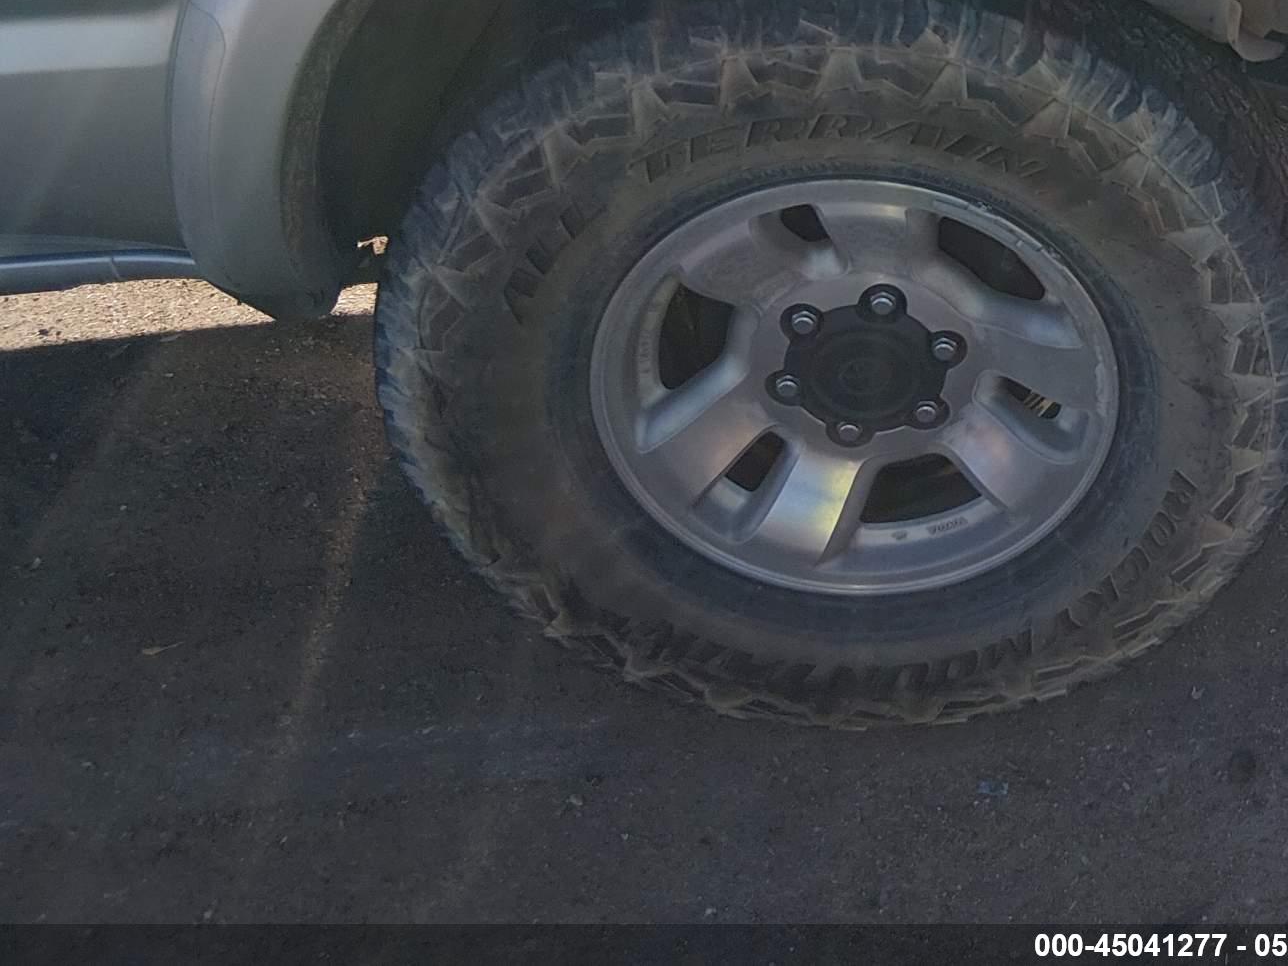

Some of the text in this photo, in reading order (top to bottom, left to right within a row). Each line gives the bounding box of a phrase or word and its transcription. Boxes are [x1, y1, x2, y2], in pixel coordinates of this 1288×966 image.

[503, 112, 1048, 325] ALL TERRAIN
[1056, 469, 1198, 632] ROCKY
